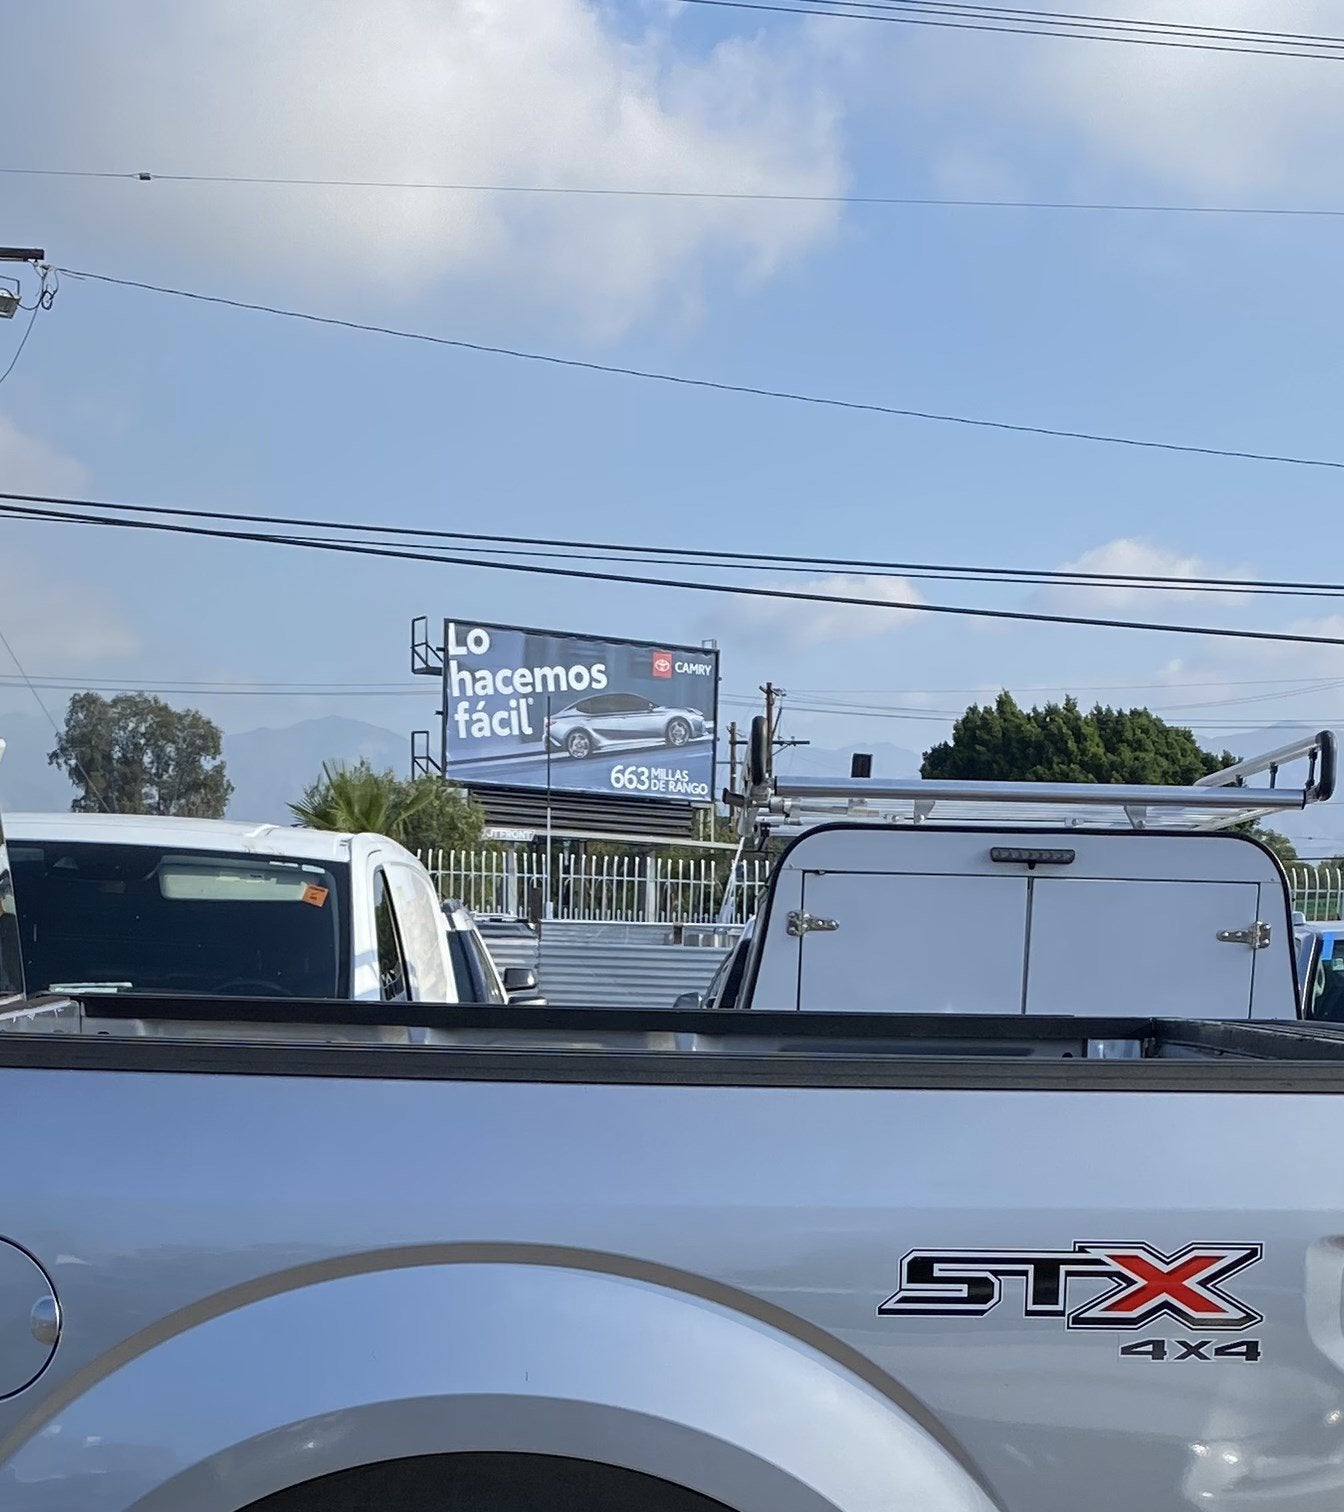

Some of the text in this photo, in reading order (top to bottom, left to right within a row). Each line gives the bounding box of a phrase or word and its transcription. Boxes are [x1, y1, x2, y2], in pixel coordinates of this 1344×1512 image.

[448, 622, 490, 656] Lo
[449, 659, 608, 697] hacemos
[674, 661, 712, 677] CAMRY
[610, 765, 650, 791] 663
[650, 767, 689, 782] MILLAS
[650, 780, 708, 795] DE RANGO
[876, 1240, 1264, 1331] STX
